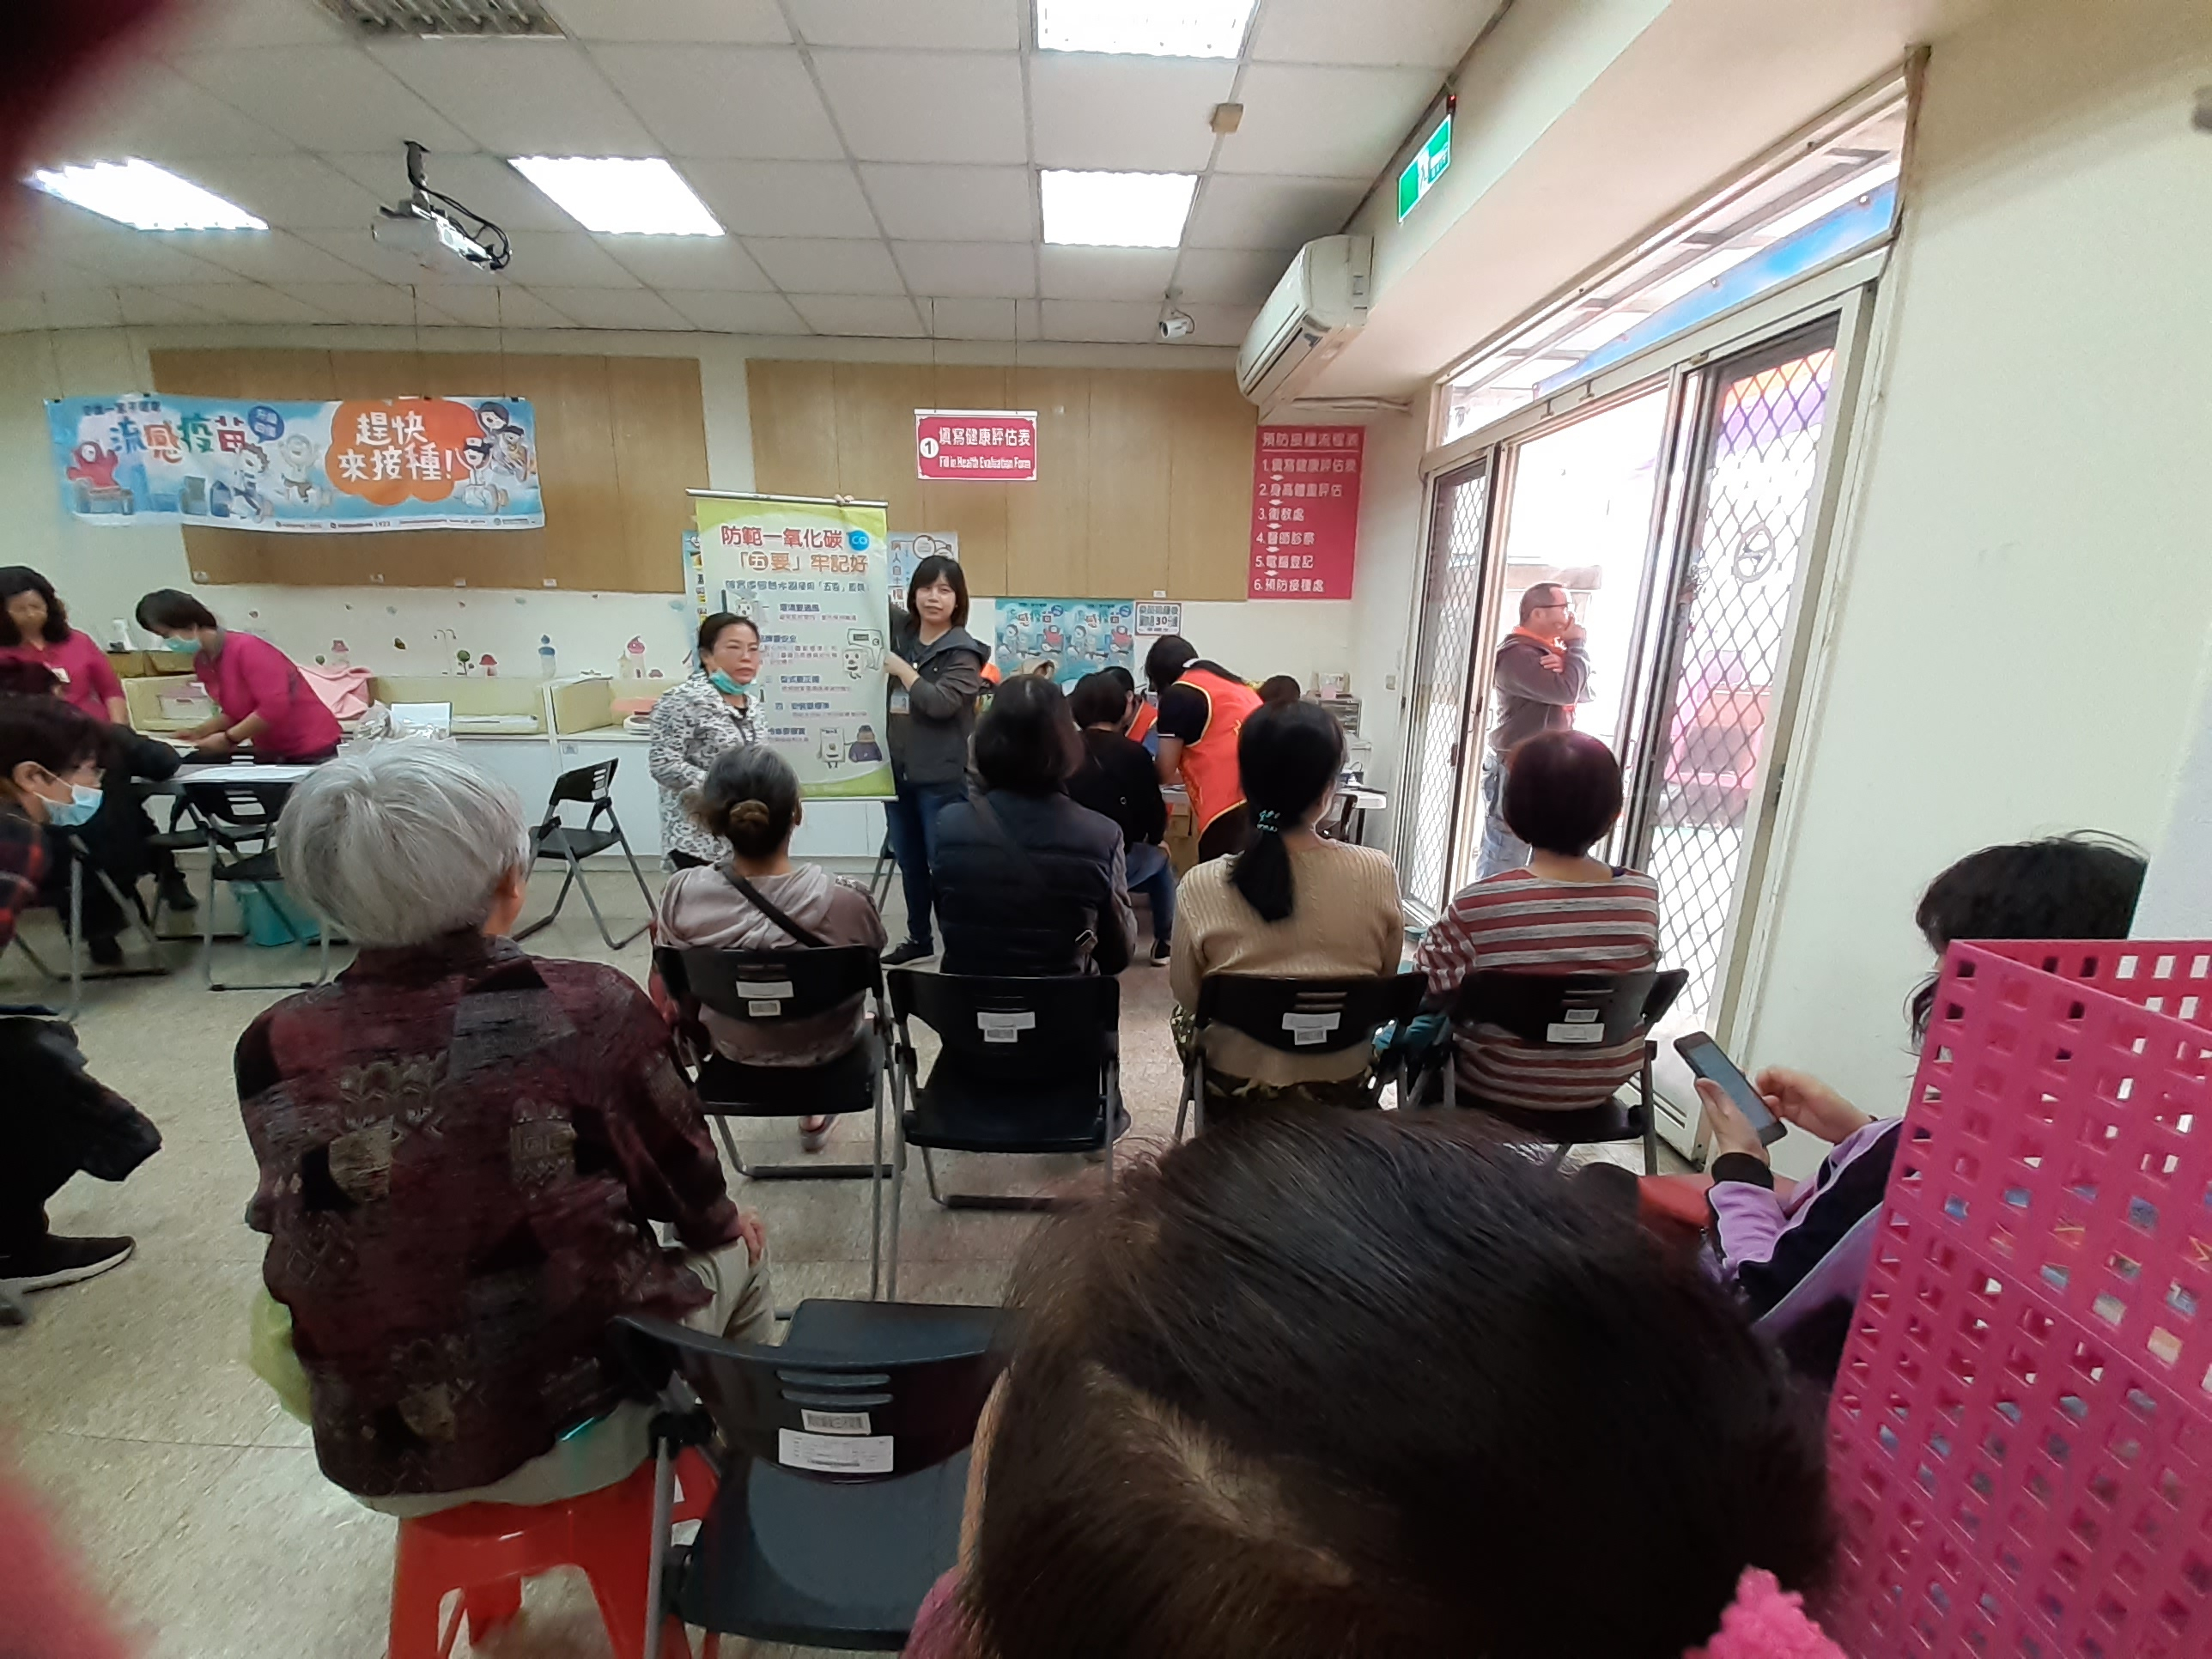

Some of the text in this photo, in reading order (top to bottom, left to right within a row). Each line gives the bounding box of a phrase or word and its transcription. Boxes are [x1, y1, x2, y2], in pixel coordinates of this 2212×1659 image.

[109, 412, 246, 464] 流感疫苗
[356, 410, 428, 446] 趕快
[721, 526, 843, 550] 防範一氧化碳
